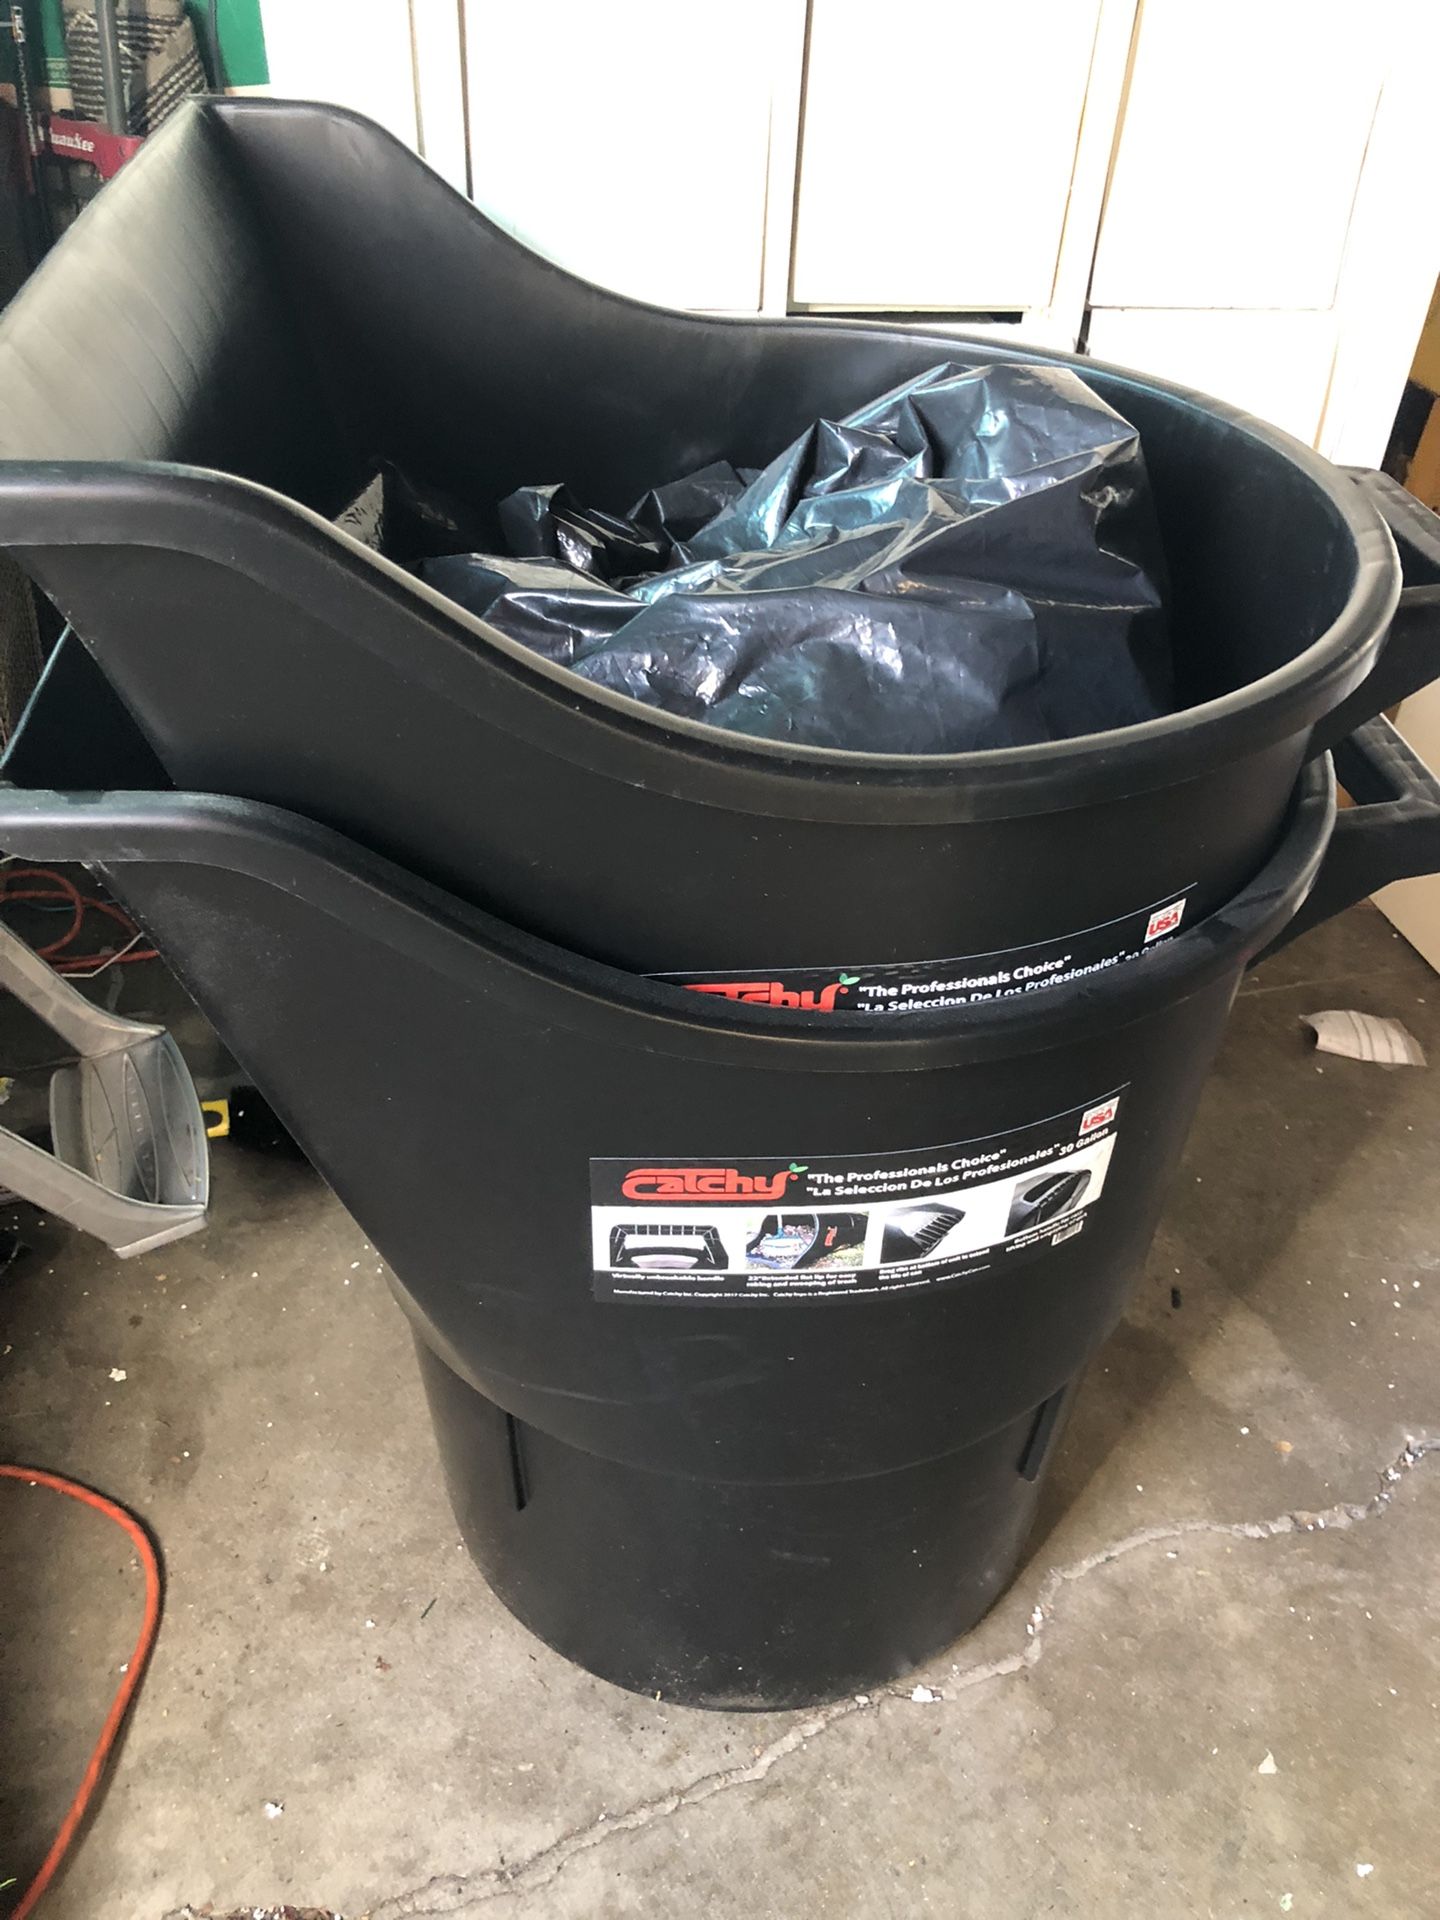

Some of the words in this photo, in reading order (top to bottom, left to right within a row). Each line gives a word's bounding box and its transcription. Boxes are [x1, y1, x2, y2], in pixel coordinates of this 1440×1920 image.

[1148, 911, 1179, 935] USA
[858, 984, 899, 998] "The
[901, 970, 1011, 996] Professionals
[1012, 954, 1072, 980] Choice"
[887, 996, 967, 1011] Seleccion
[1025, 950, 1126, 991] Profesionales"
[806, 1187, 832, 1197] "La
[834, 1182, 908, 1196] Seleccion
[910, 1178, 932, 1189] De
[934, 1175, 960, 1187] Los
[962, 1143, 1061, 1180] Profesionales"
[1058, 1143, 1075, 1156] 30
[1075, 1127, 1109, 1149] Gallon
[807, 1173, 845, 1184] "The
[846, 1162, 949, 1183] Professionals
[950, 1148, 1007, 1170] Choice"
